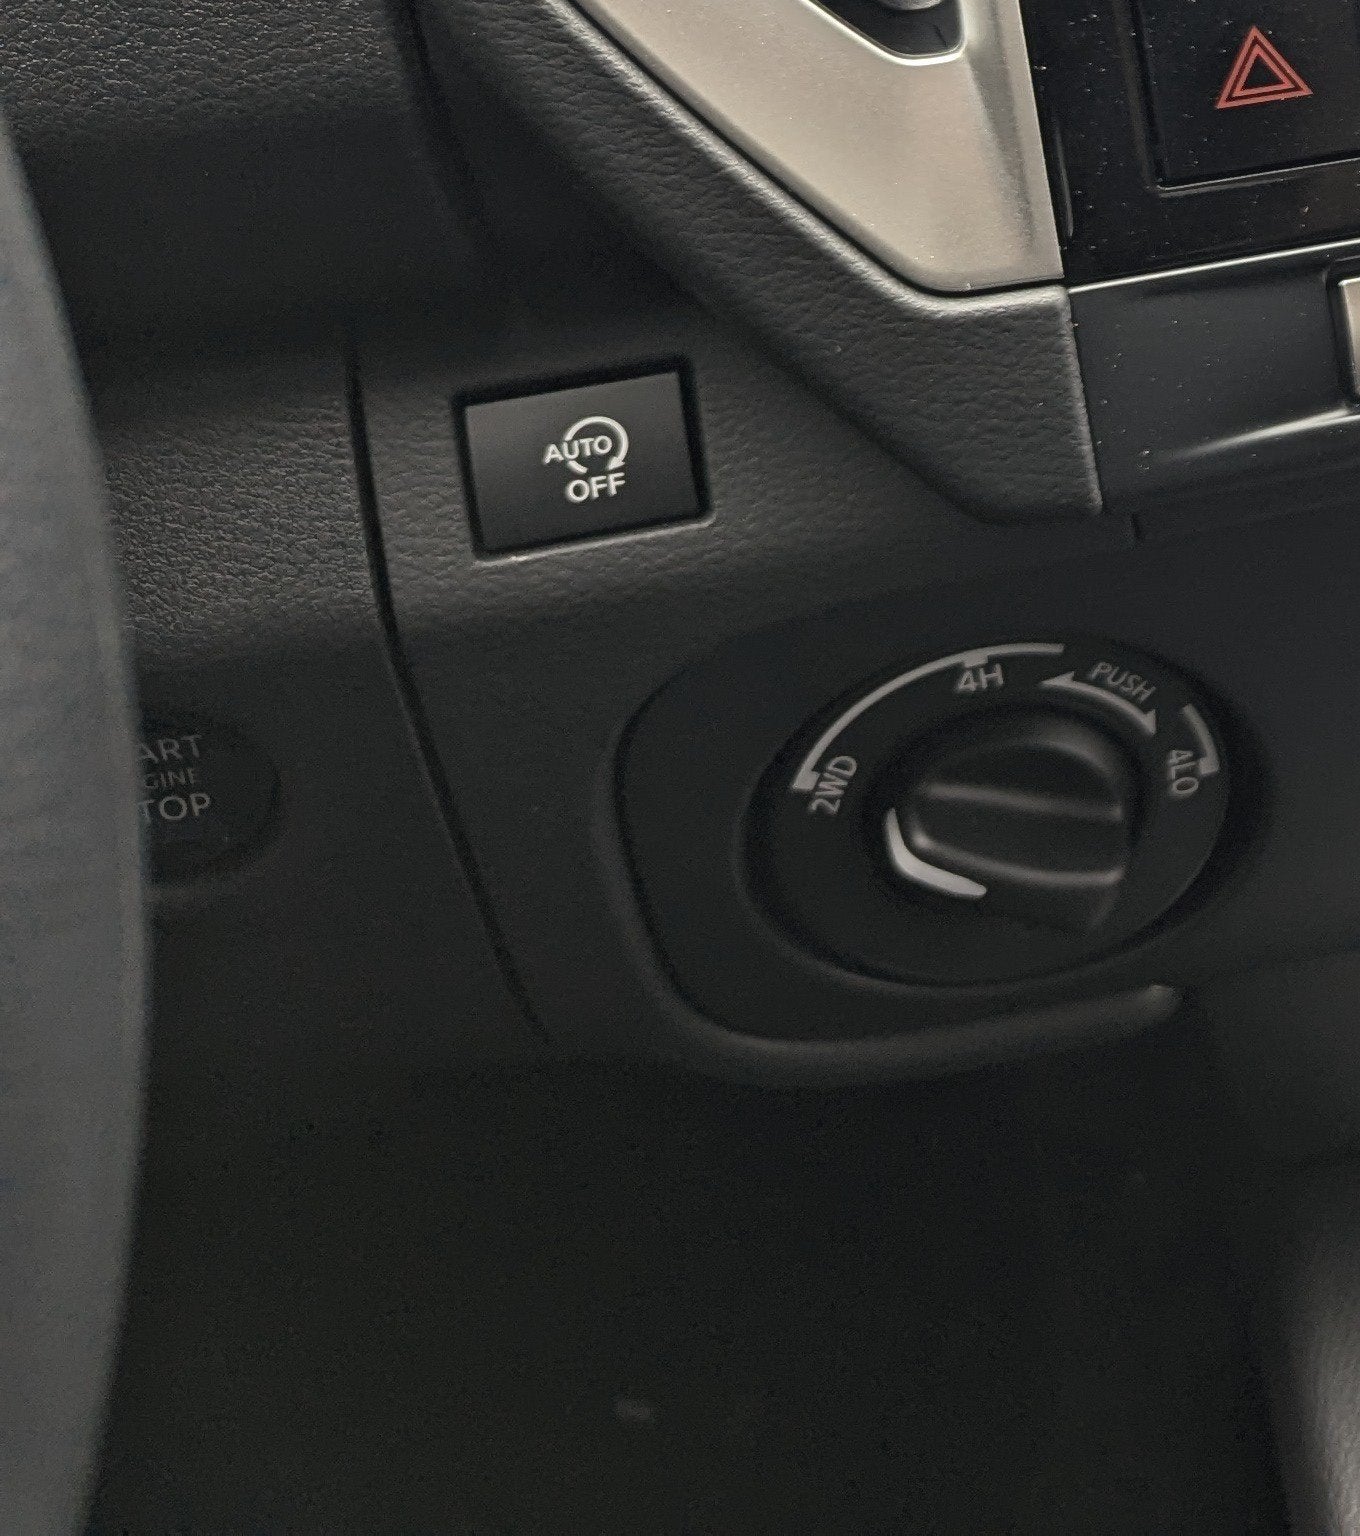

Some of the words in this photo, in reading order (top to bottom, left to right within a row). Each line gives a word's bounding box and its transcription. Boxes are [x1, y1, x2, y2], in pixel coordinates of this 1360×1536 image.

[543, 434, 613, 465] AUTO
[564, 470, 626, 504] OFF
[955, 665, 1005, 693] 4H
[1091, 661, 1156, 702] PUSH
[137, 734, 201, 764] ART
[144, 766, 198, 790] GINE
[808, 754, 858, 816] 2WD
[1167, 748, 1199, 798] 4LO
[138, 791, 211, 823] TOP
